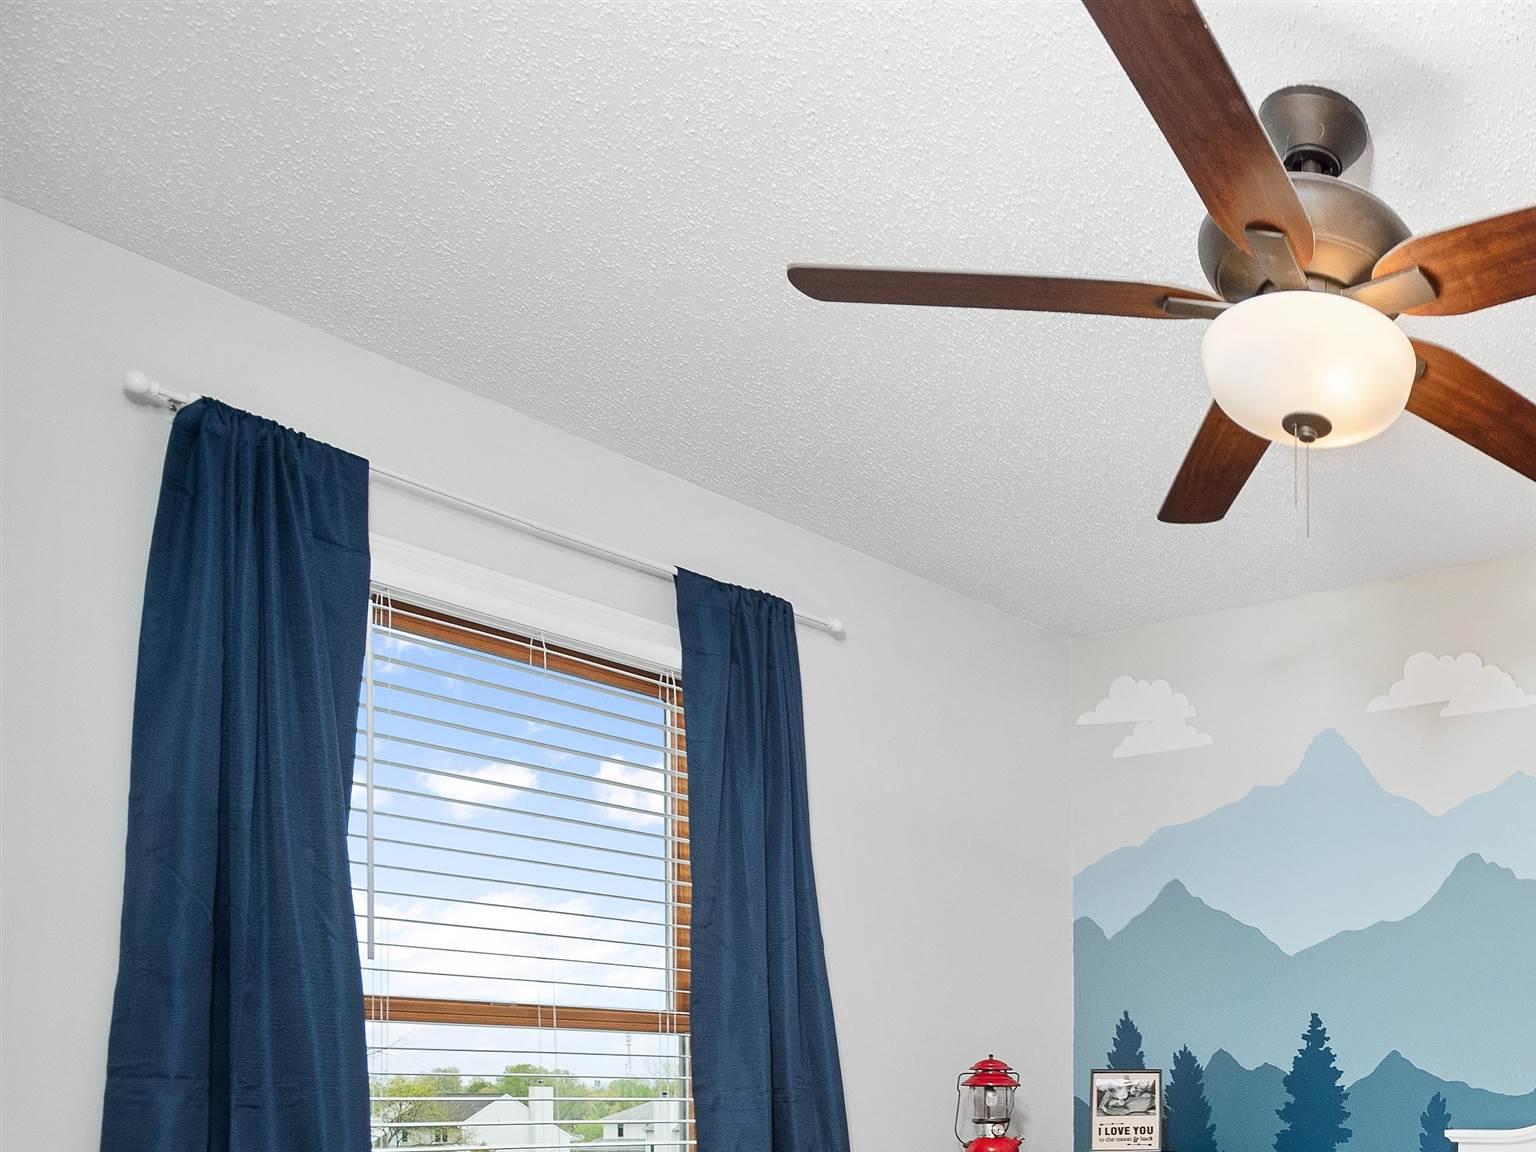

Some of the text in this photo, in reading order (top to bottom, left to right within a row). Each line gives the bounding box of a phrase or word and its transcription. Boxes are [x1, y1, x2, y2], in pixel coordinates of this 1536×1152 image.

[1098, 1126, 1154, 1136] I LOVE YOU
